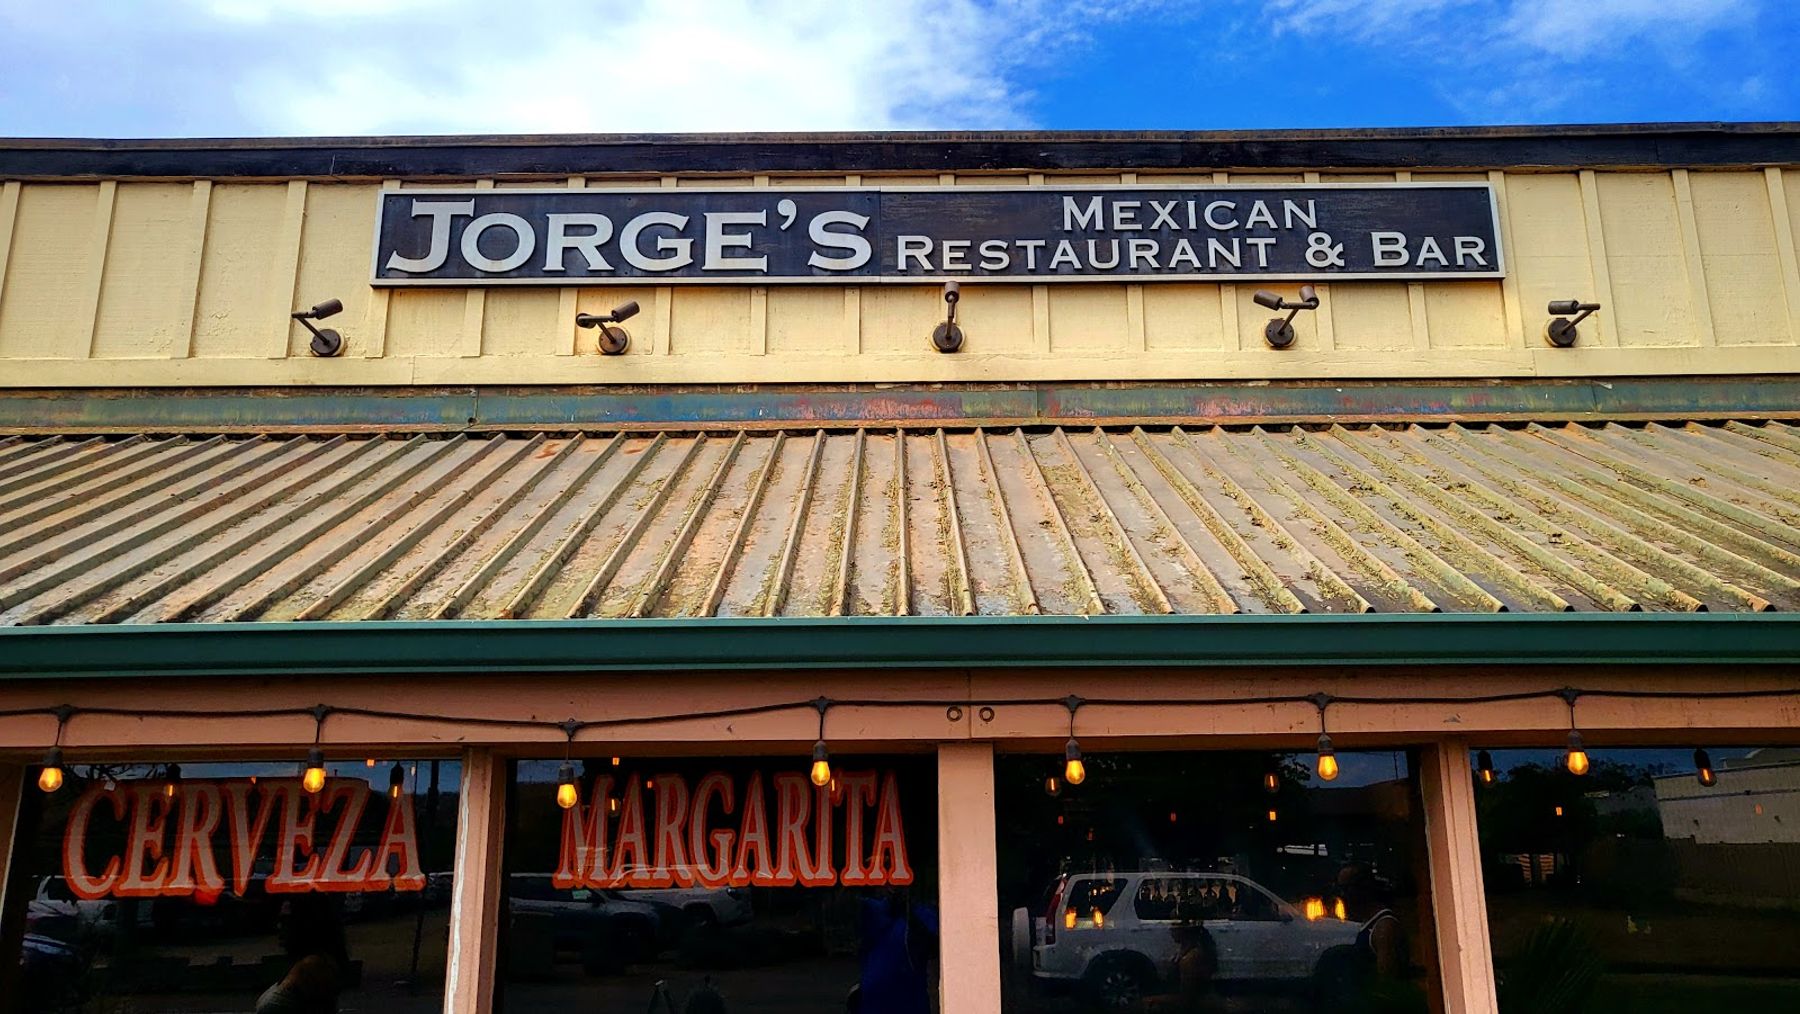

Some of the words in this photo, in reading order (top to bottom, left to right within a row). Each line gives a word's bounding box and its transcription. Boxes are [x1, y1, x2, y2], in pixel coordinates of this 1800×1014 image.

[386, 198, 873, 273] JORGE'S
[1062, 195, 1318, 231] MEXICAN
[896, 235, 1277, 271] RESTAURANT
[1304, 231, 1345, 268] &
[1371, 231, 1488, 268] BAR
[62, 776, 427, 900] CERVEZA
[551, 769, 914, 890] MARGARITA
